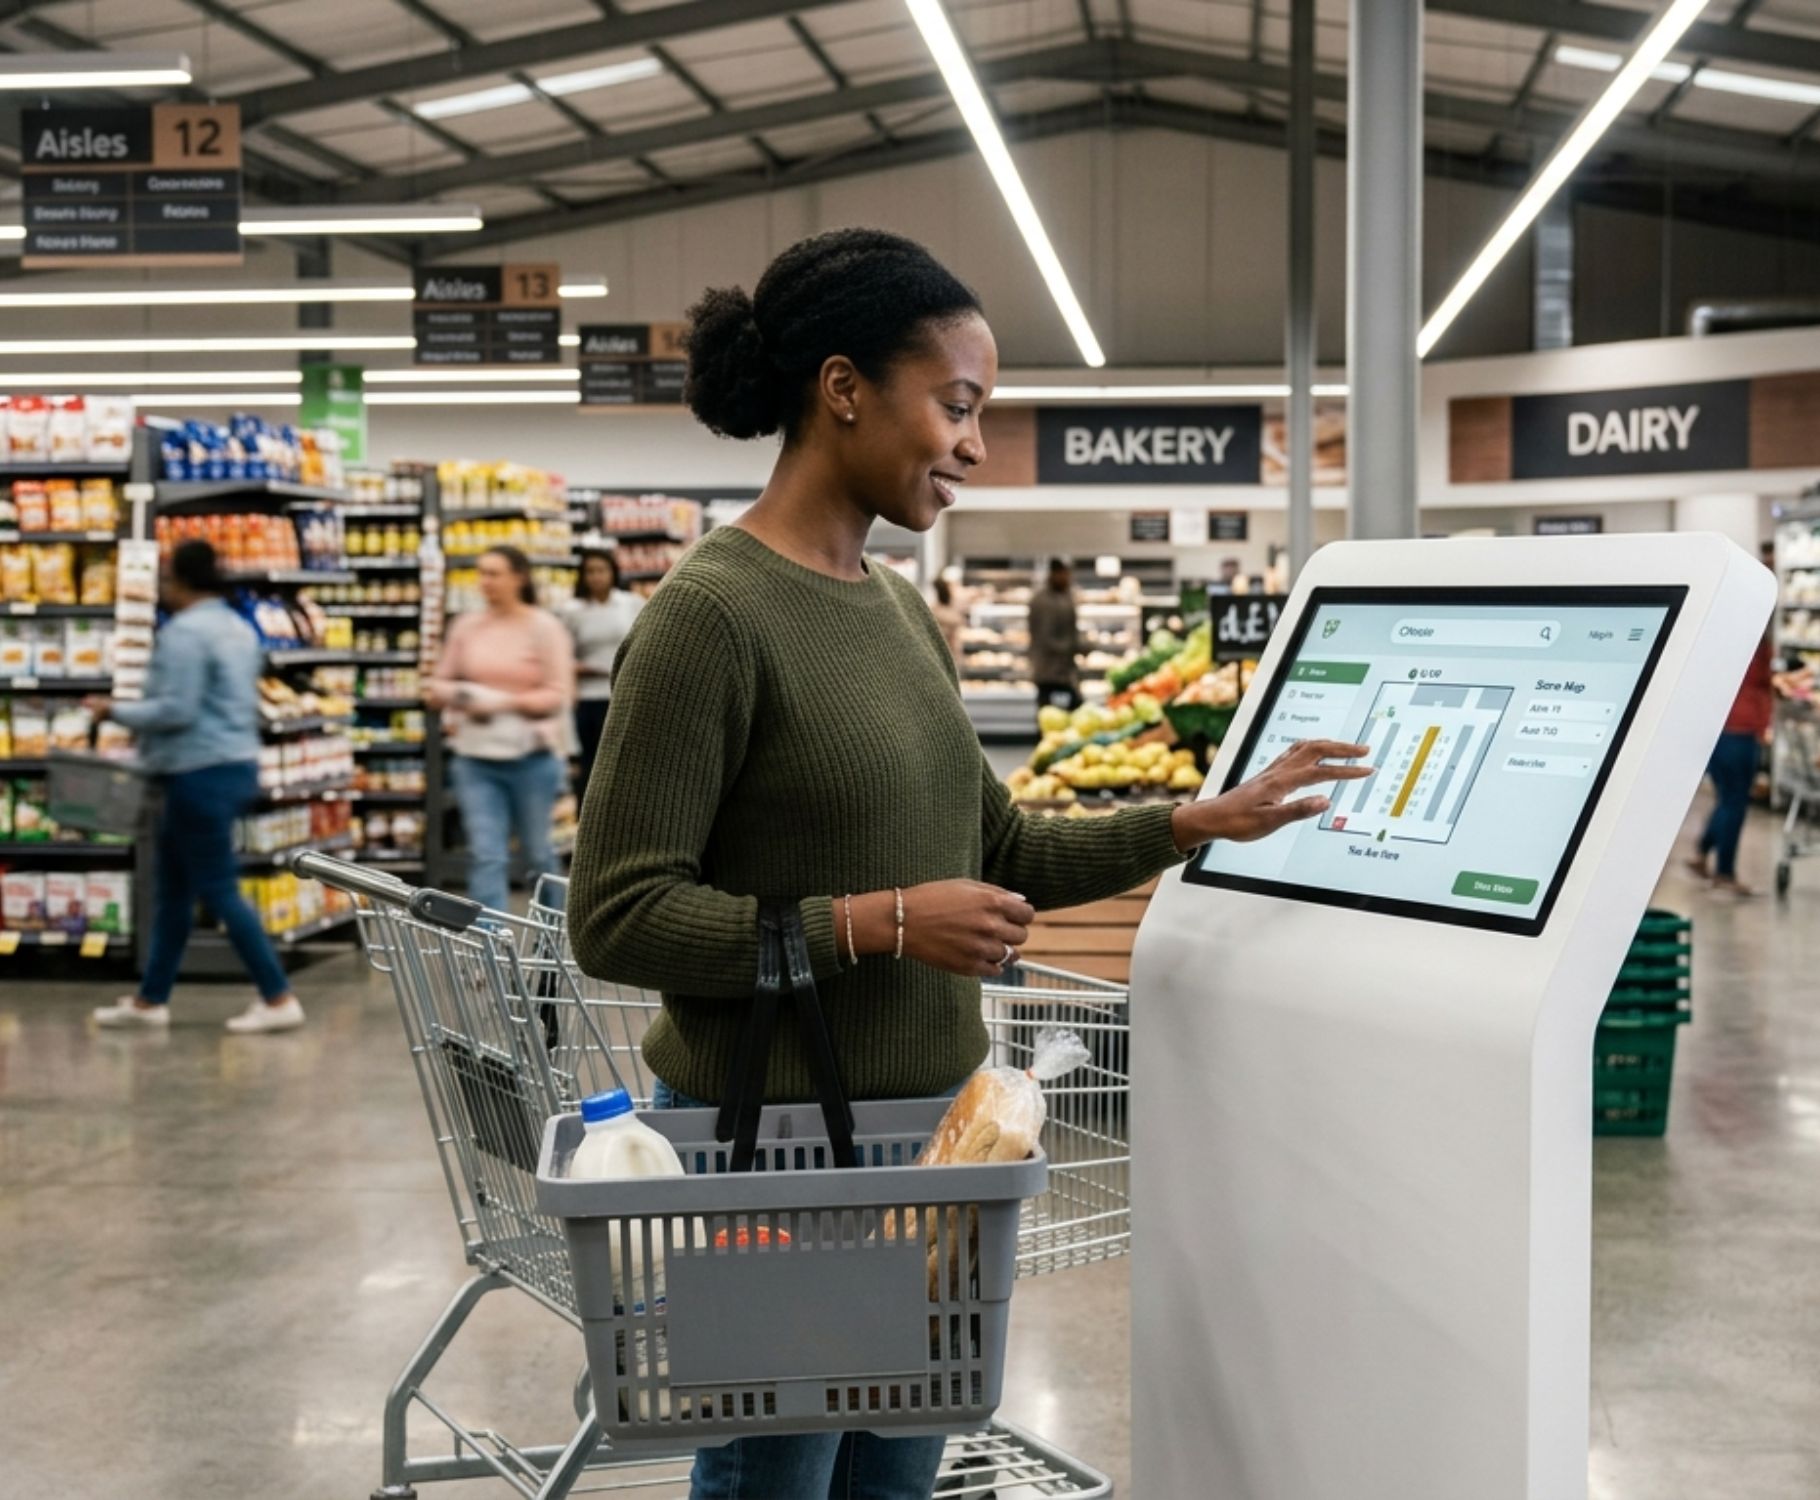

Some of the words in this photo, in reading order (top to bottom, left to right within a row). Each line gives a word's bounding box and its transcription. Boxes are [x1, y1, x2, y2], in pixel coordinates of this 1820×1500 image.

[35, 127, 129, 159] Aisles
[175, 118, 222, 157] 12
[422, 278, 487, 300] Aisles
[517, 271, 549, 298] 13
[1063, 425, 1235, 465] BAKERY
[1567, 404, 1700, 457] DAIRY
